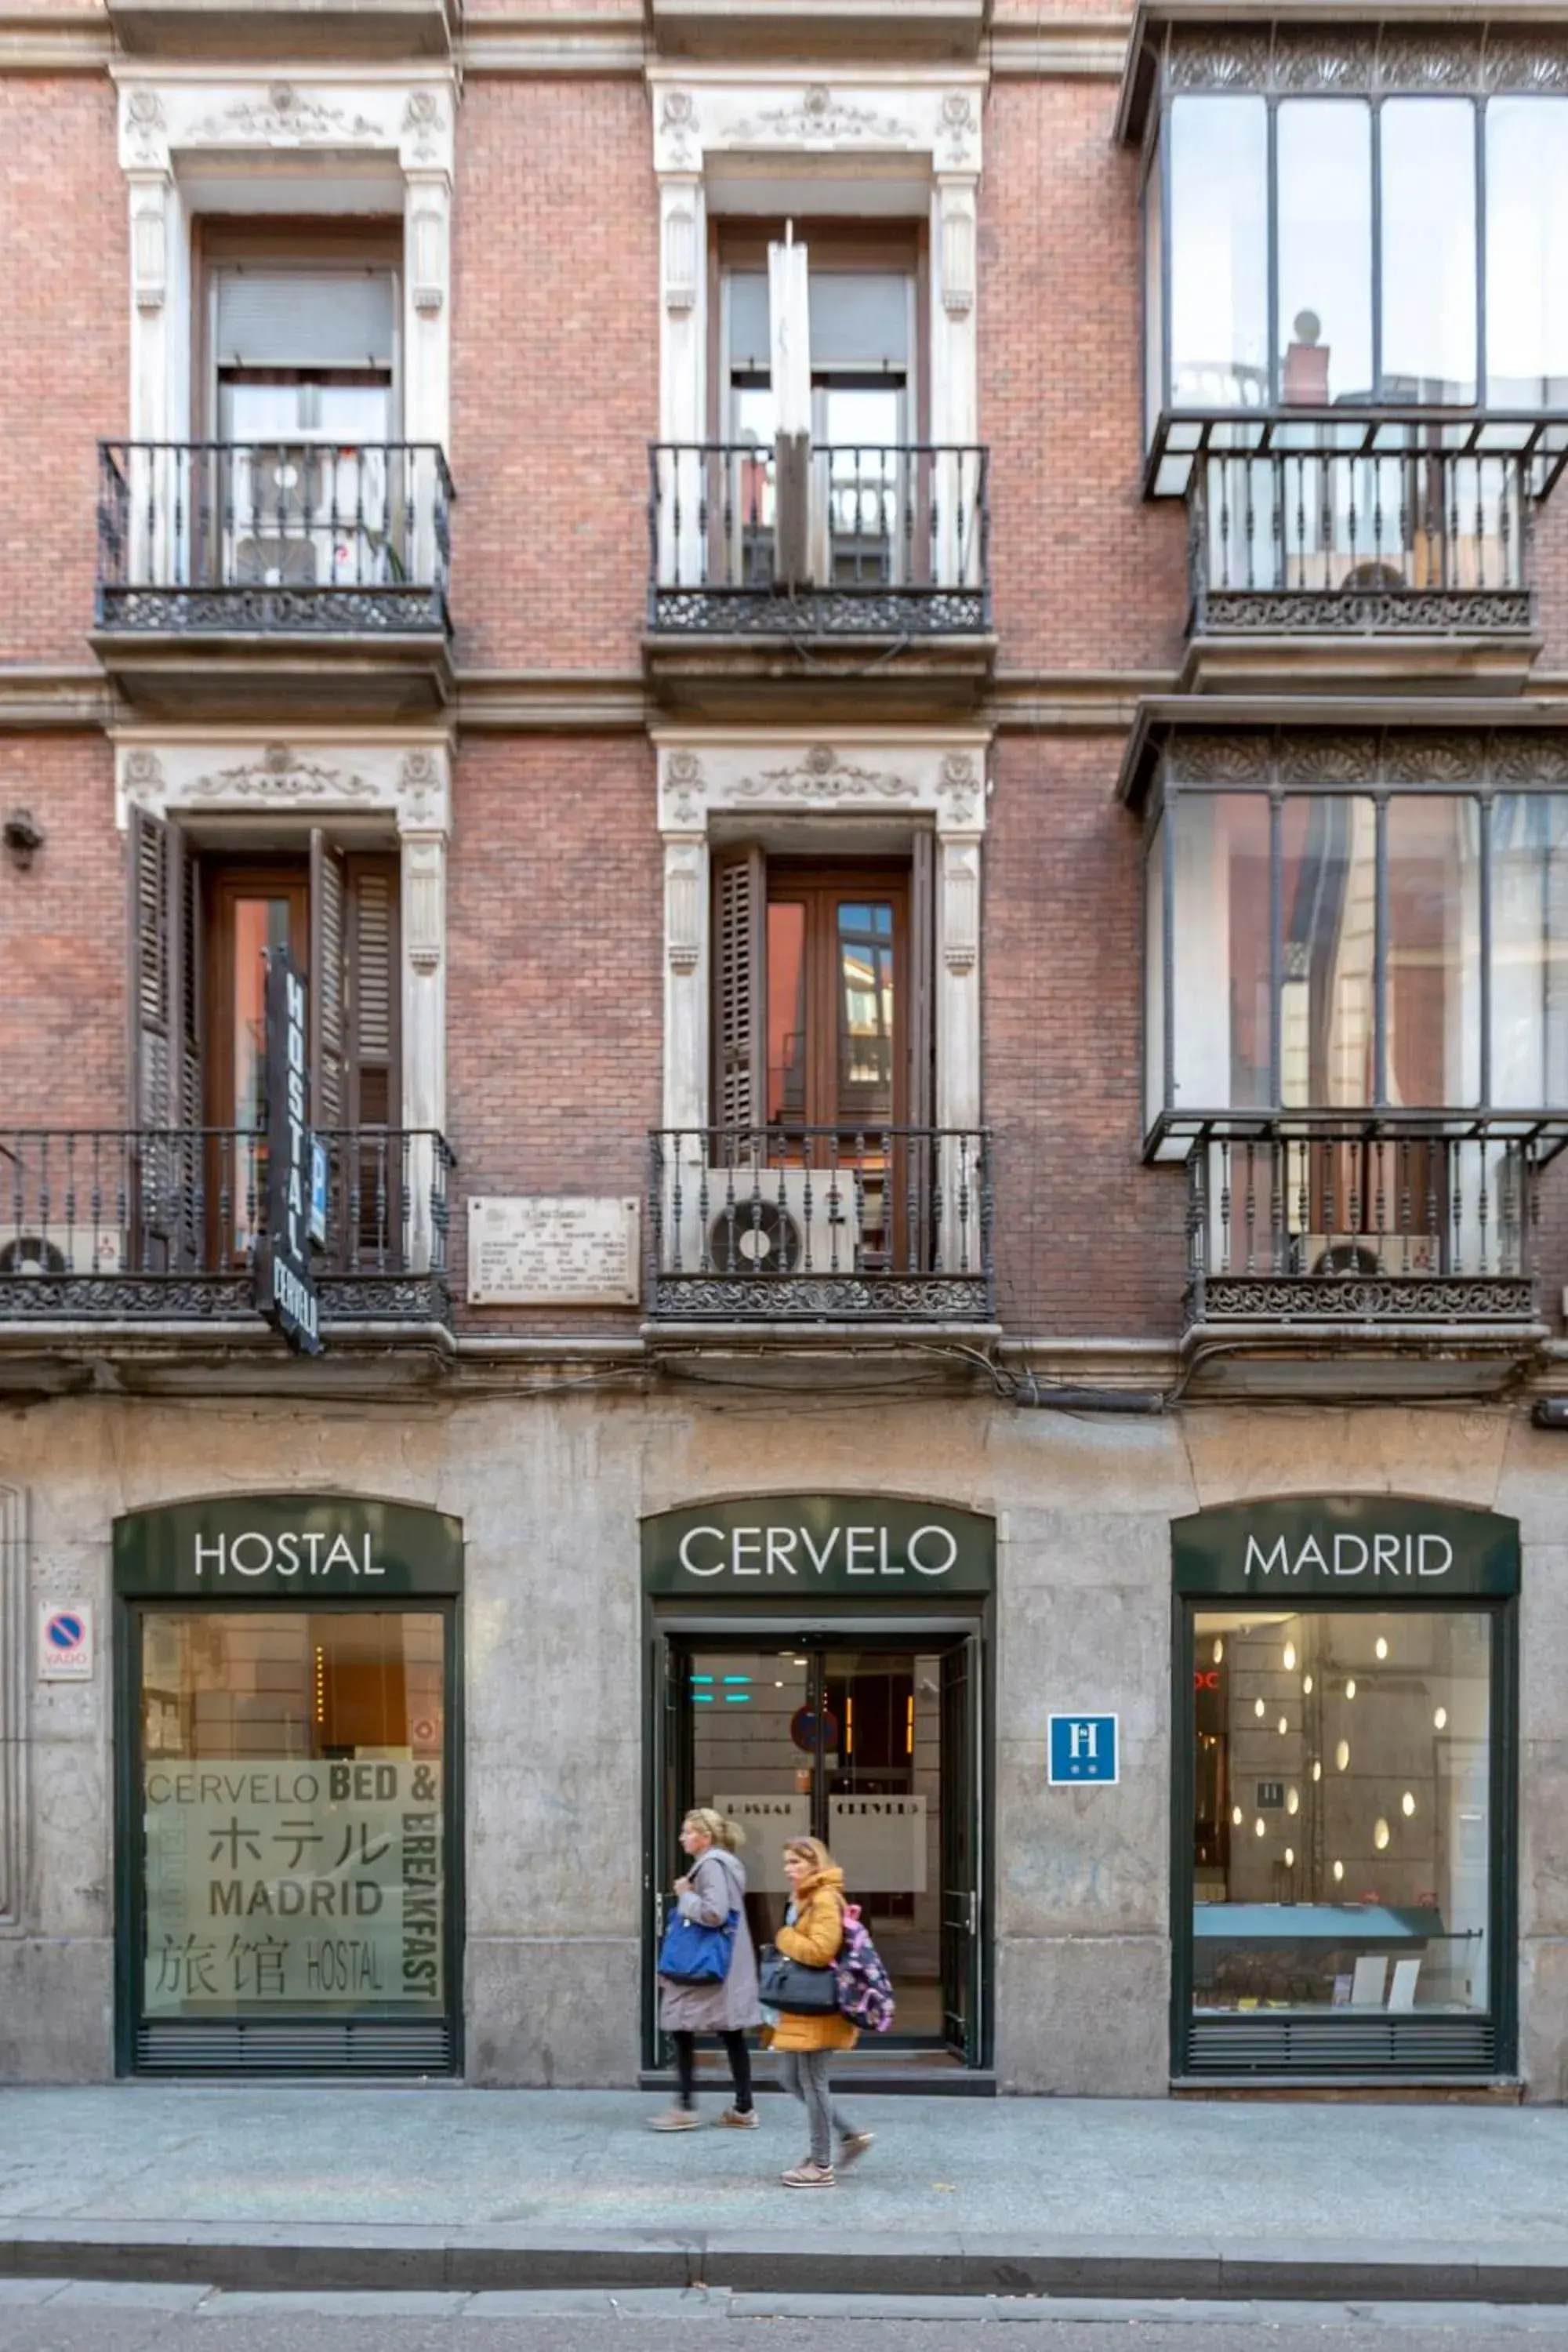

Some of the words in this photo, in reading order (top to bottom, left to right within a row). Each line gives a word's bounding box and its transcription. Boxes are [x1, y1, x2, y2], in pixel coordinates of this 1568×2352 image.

[285, 971, 304, 1263] HOSTAL
[274, 1254, 318, 1338] CERVELO
[194, 1532, 386, 1576] HOSTAL
[678, 1525, 958, 1577] CERVELO
[1243, 1534, 1454, 1577] MADRID
[147, 1773, 320, 1804] CERVELO
[329, 1764, 397, 1802] BED
[411, 1764, 436, 1802] &
[208, 1817, 390, 1870] ホテル
[209, 1879, 383, 1917] MADRID
[401, 1813, 437, 1998] BREAKFAST
[154, 1933, 290, 1995] 旅馆
[307, 1939, 383, 1992] HOSTAL
